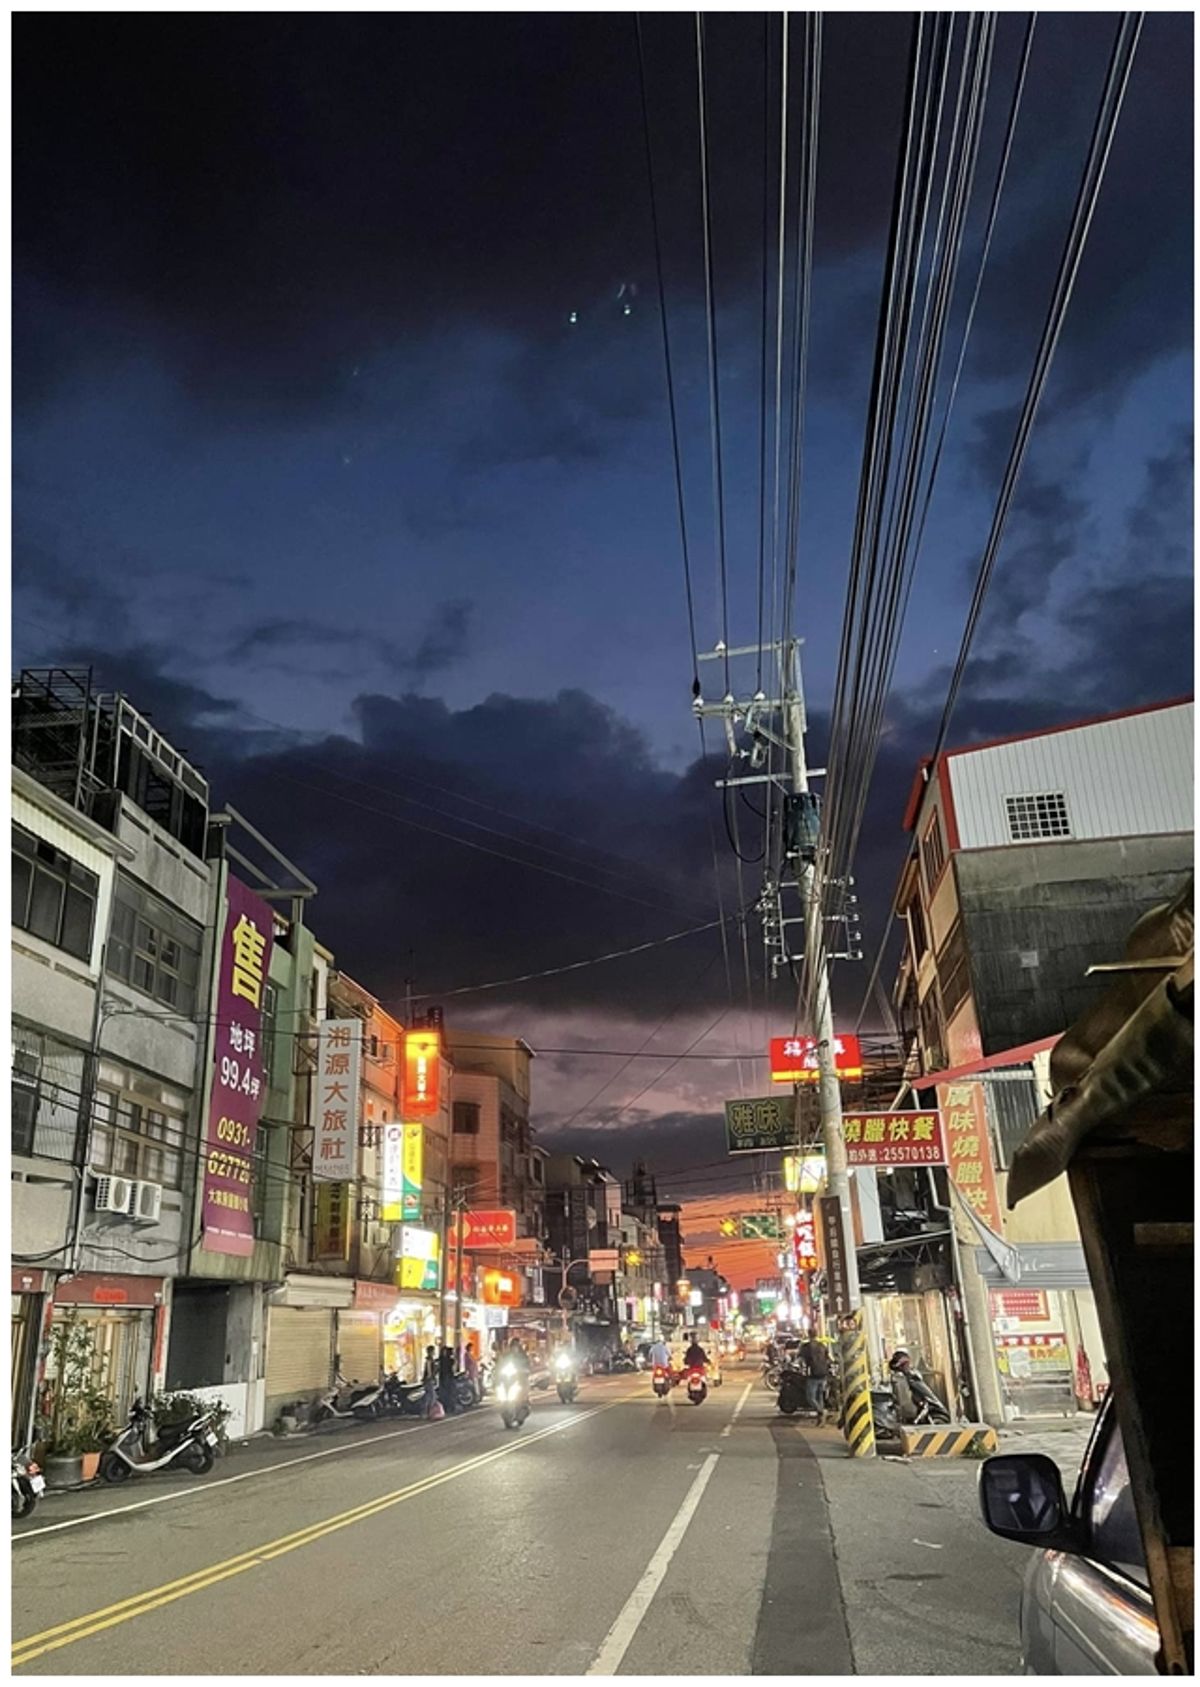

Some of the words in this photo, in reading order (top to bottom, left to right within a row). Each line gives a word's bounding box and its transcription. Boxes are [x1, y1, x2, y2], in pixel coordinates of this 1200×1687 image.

[232, 913, 267, 1009] 售
[229, 1020, 256, 1059] 地坪
[220, 1056, 261, 1100] 99.4坪
[321, 1026, 350, 1160] 湘源大旅社
[217, 1116, 251, 1147] 0931-
[732, 1101, 779, 1135] 雅味
[843, 1117, 935, 1142] 燒臘快餐
